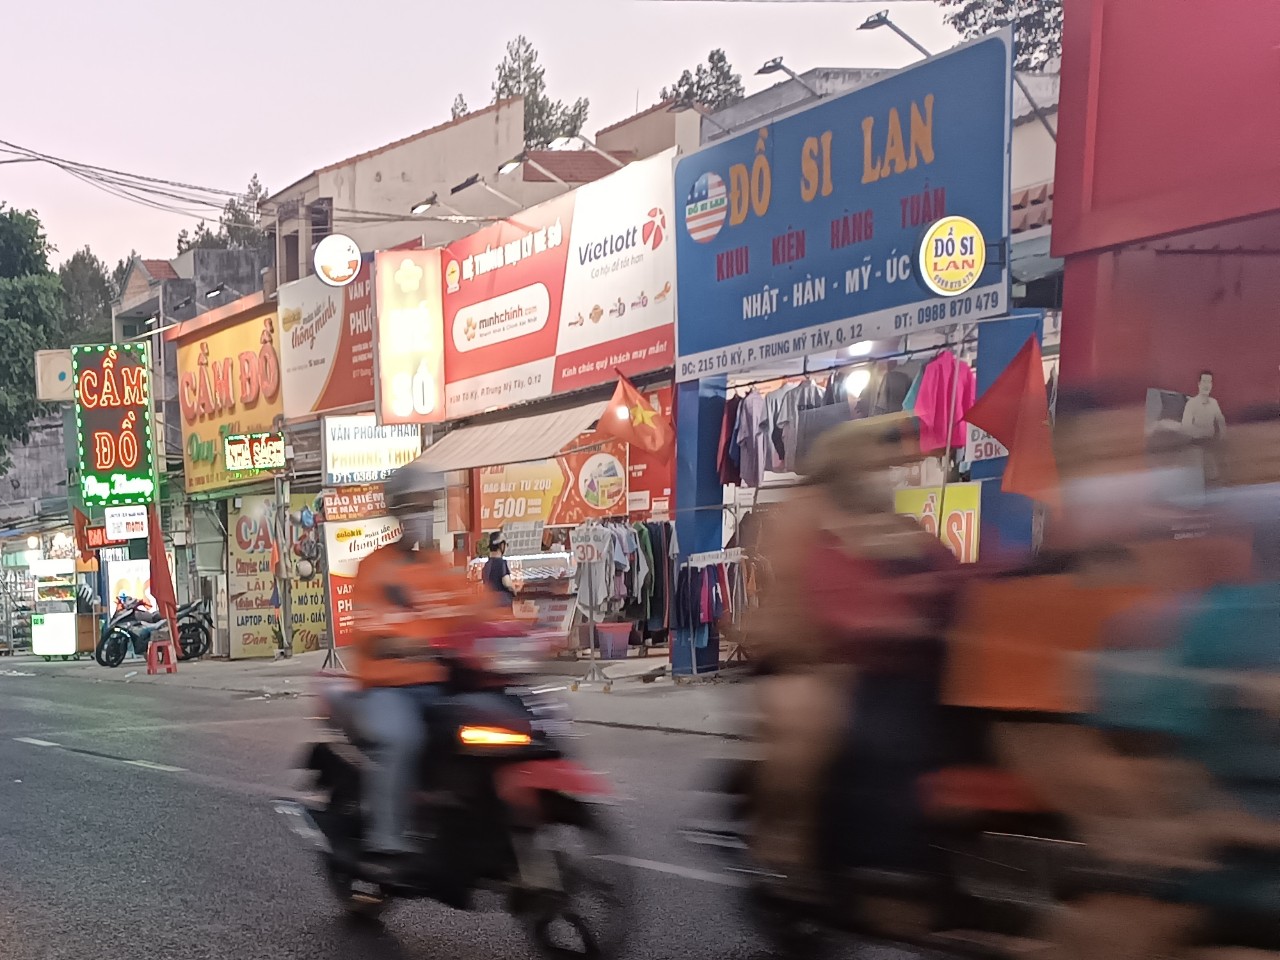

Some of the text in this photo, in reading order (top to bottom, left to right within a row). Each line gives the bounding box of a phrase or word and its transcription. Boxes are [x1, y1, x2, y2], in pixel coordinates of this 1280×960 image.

[800, 130, 833, 203] SI
[861, 93, 935, 184] LAN
[579, 226, 637, 266] Vietlott
[716, 245, 749, 282] KHUI
[772, 224, 805, 270] KIỆN
[830, 208, 873, 249] HÀNG
[933, 259, 974, 271] LAN
[960, 235, 974, 256] SI
[742, 248, 911, 320] NHẬT HÀN MỸ ÚC
[632, 348, 647, 359] may
[681, 362, 696, 377] ĐC:
[699, 357, 713, 371] 215
[716, 351, 728, 367] TÔ
[748, 348, 757, 362] P.
[760, 342, 790, 359] TRUNG
[793, 333, 807, 351] MỸ
[811, 327, 833, 347] TÂY,
[836, 327, 846, 343] Q.
[850, 324, 863, 339] 12
[894, 313, 912, 330] ĐT:
[917, 303, 946, 325] 0988
[950, 297, 971, 318] 870
[975, 291, 999, 313] 479
[79, 349, 145, 408] CẦM
[94, 410, 138, 470] ĐỒ
[493, 497, 526, 518] 500
[237, 615, 262, 626] LAPTOP
